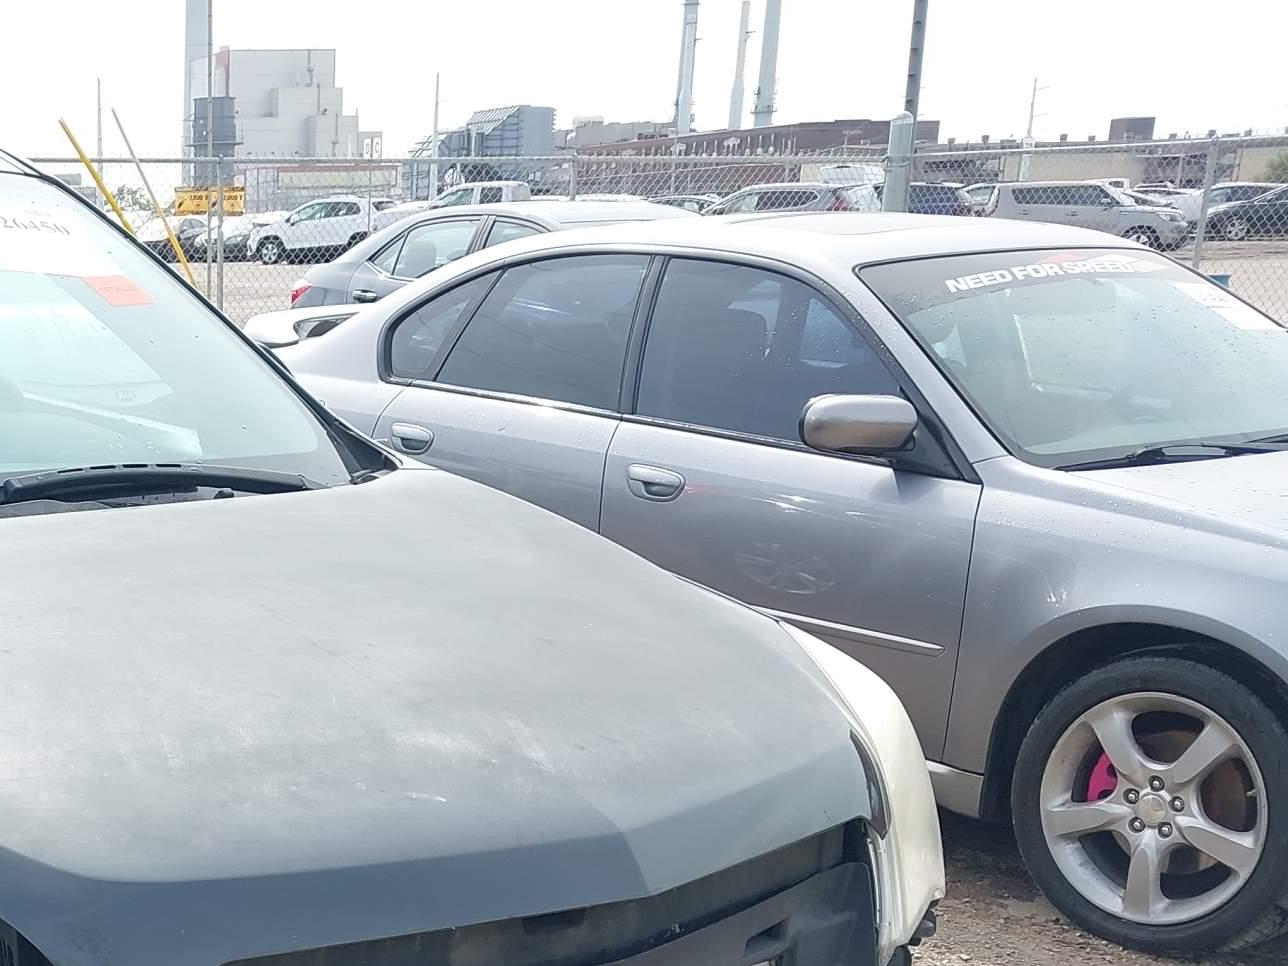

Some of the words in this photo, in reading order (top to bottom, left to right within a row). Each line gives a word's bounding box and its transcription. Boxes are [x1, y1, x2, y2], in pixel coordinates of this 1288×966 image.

[944, 269, 1013, 293] NEED
[1011, 263, 1065, 281] FOR
[1062, 260, 1136, 274] SPEED
